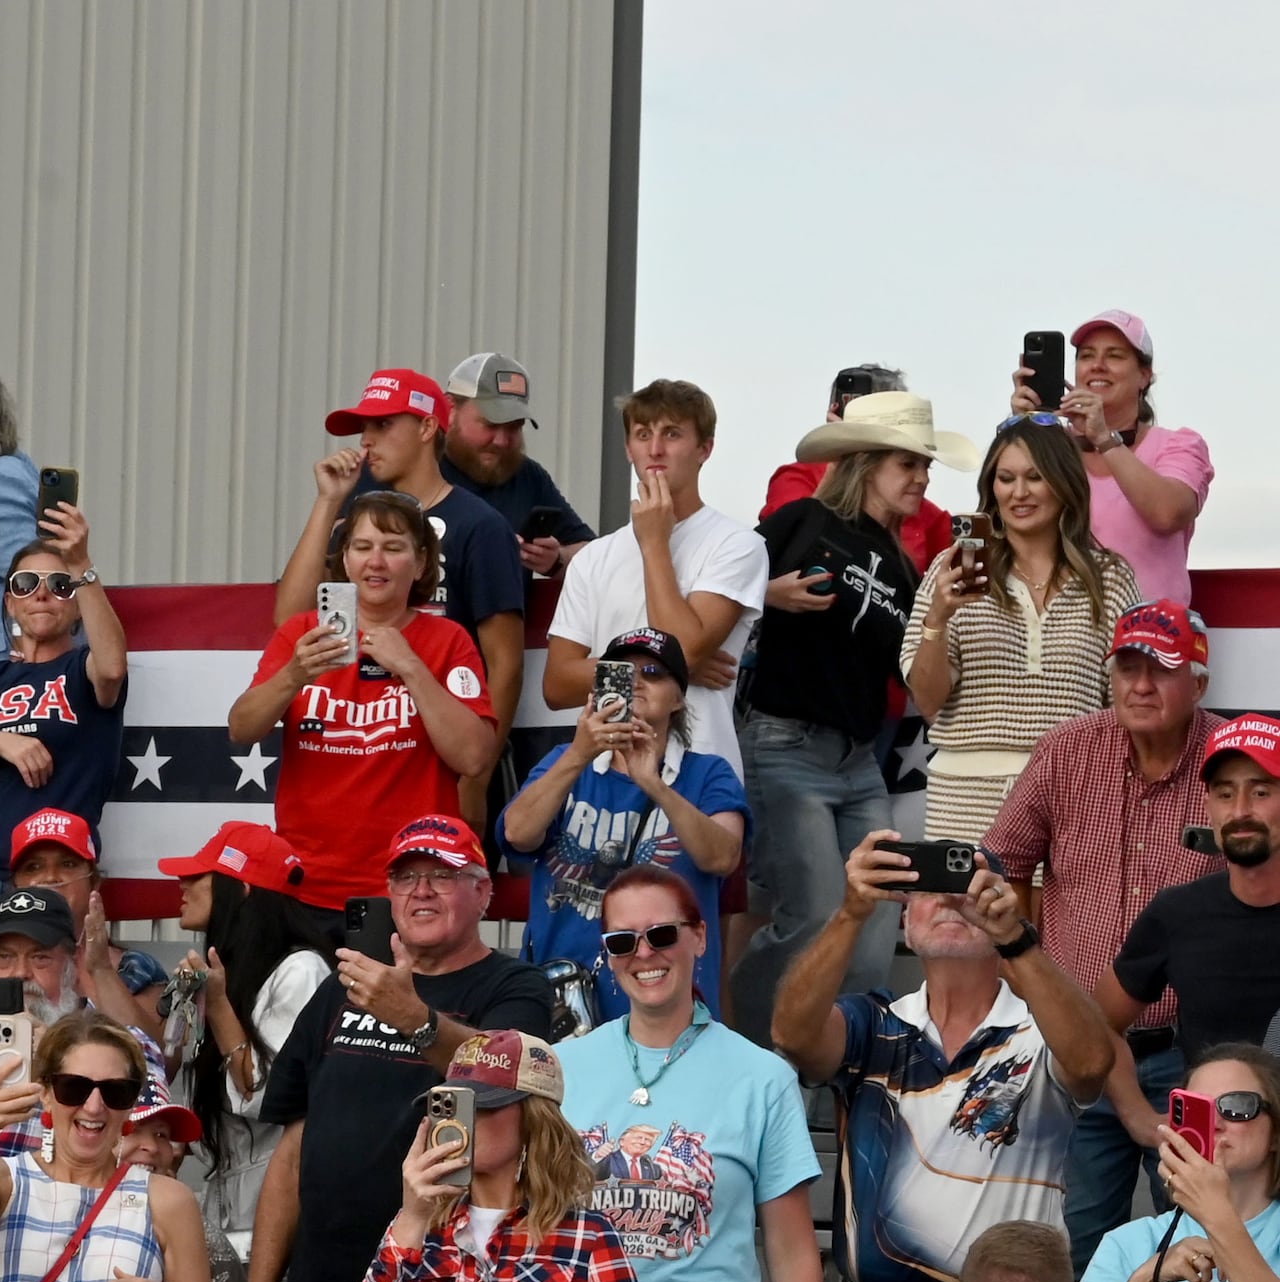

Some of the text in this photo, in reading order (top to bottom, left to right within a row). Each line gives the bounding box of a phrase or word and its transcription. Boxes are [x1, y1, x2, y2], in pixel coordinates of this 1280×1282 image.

[1122, 612, 1180, 638] TRUMP
[301, 685, 419, 729] Trump
[1214, 722, 1238, 742] MAKE
[322, 743, 364, 756] America
[364, 744, 390, 756] Great
[389, 737, 418, 751] Again
[1244, 735, 1276, 751] AGAIN
[26, 813, 71, 832] TRUMP
[400, 819, 458, 838] TRUMP
[351, 1035, 386, 1049] AMERICA
[472, 1047, 511, 1072] People
[41, 1129, 54, 1163] TRUMP
[590, 1187, 695, 1220] NALD TRUMP
[645, 1235, 658, 1246] GA
